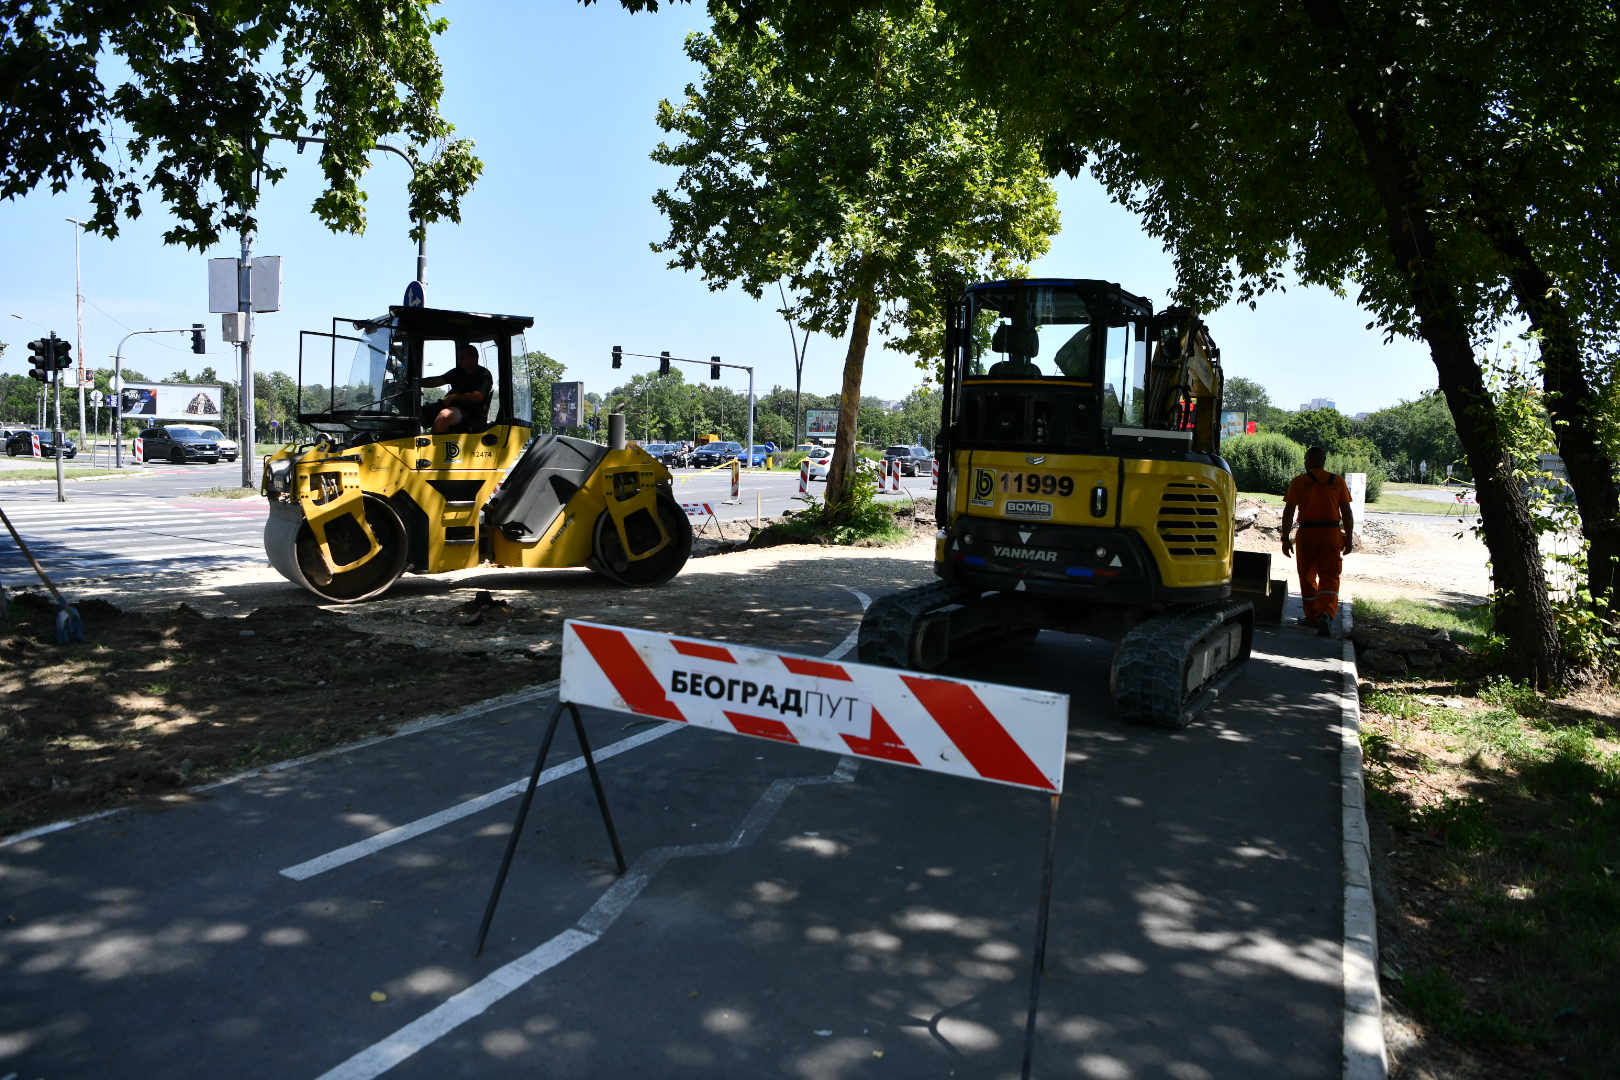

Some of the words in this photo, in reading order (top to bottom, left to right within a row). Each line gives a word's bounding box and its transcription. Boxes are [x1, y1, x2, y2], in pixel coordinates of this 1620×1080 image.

[1001, 472, 1074, 497] 11999
[1007, 502, 1050, 512] BOMIS
[993, 545, 1058, 561] YANMAR
